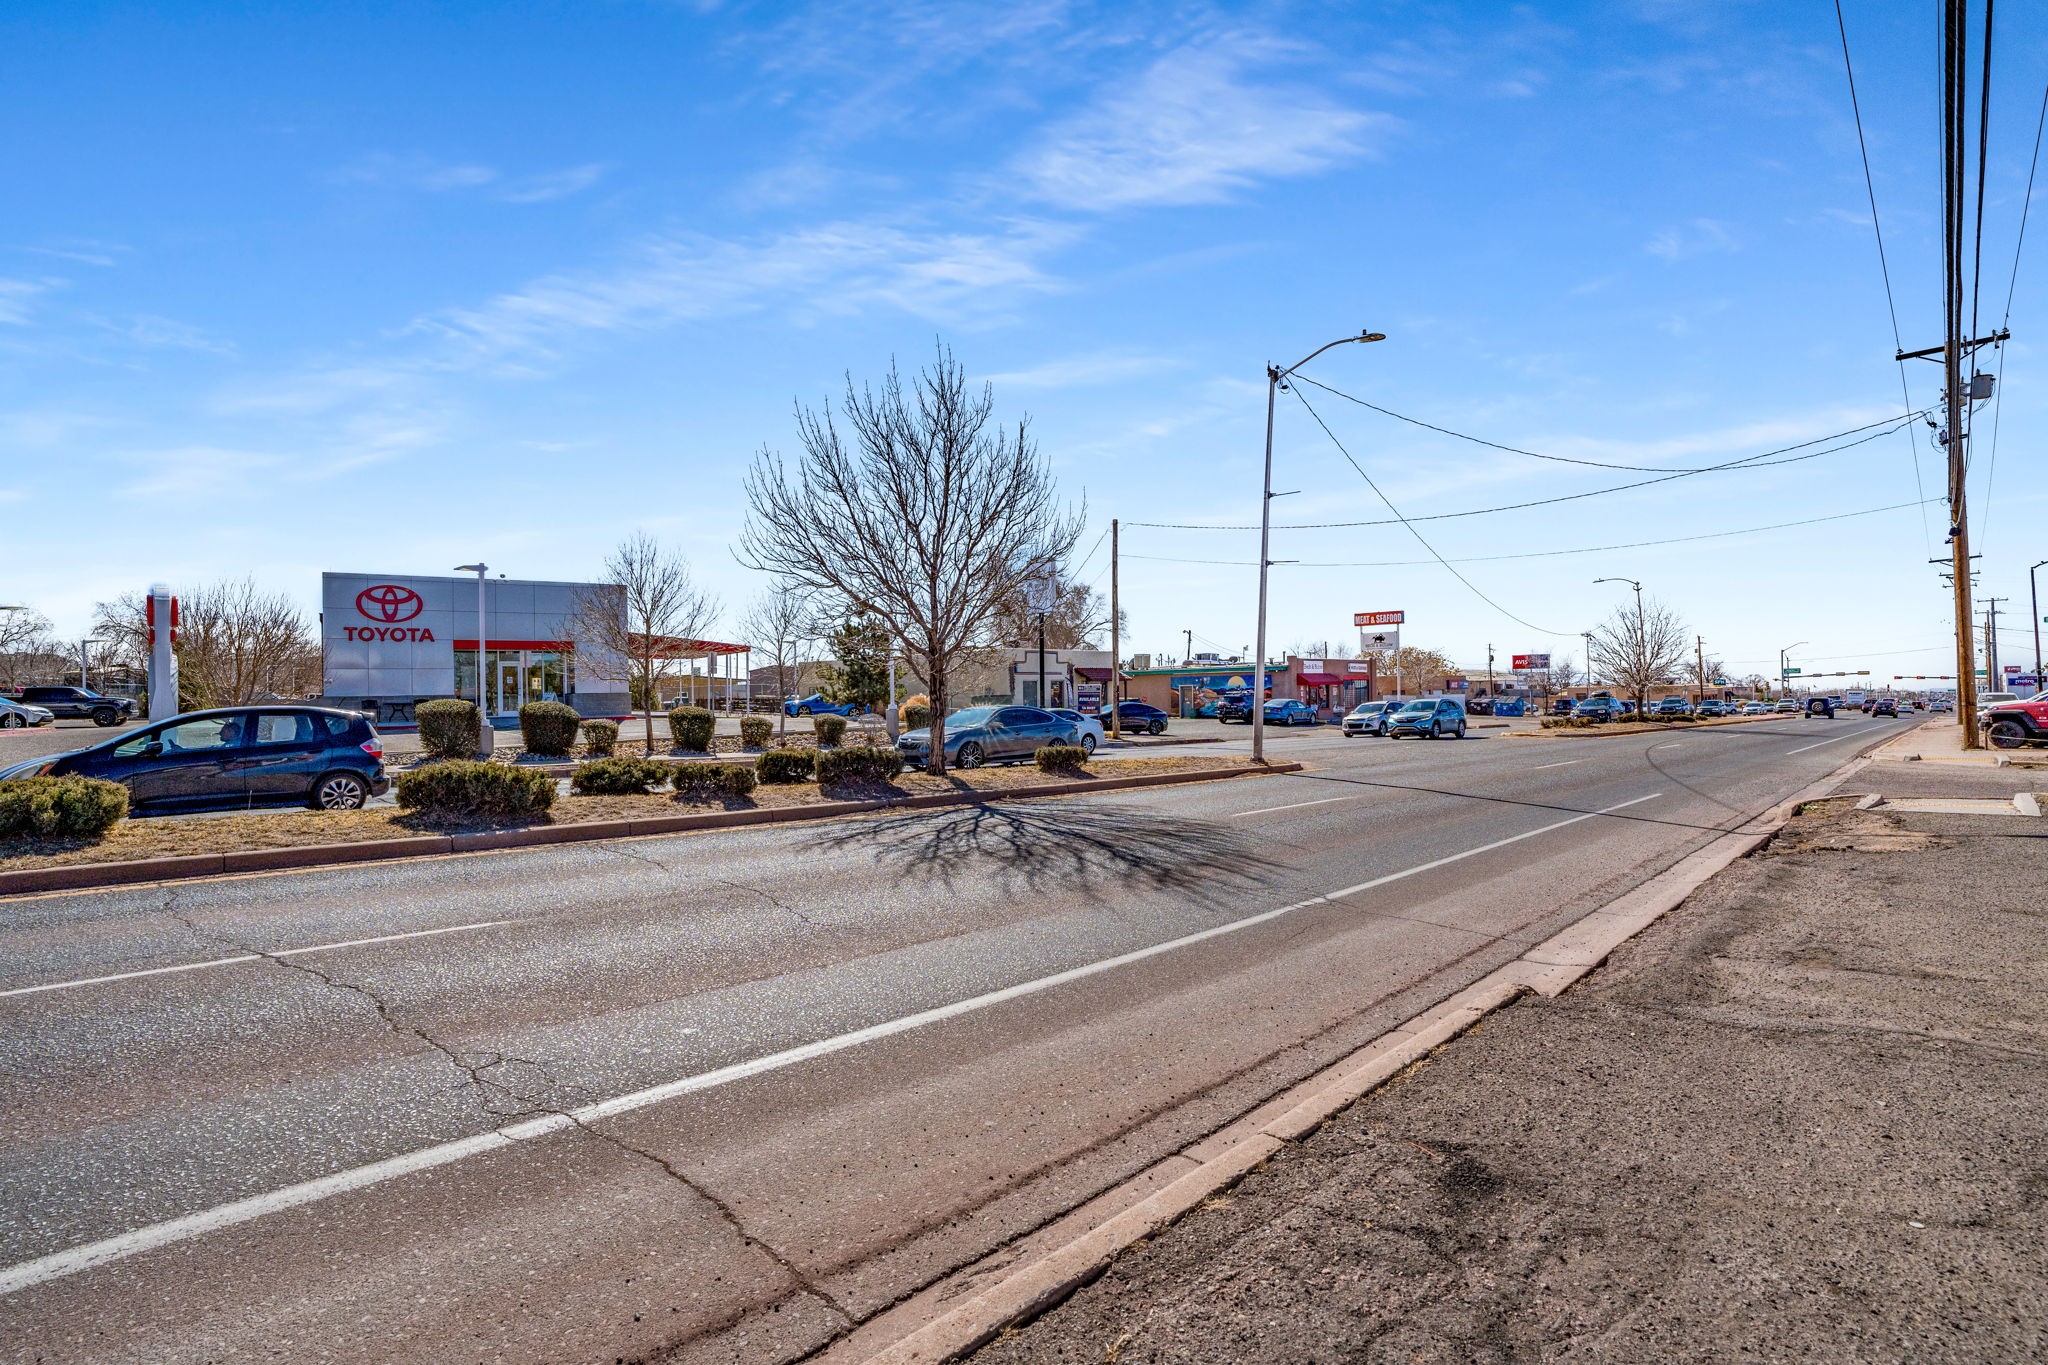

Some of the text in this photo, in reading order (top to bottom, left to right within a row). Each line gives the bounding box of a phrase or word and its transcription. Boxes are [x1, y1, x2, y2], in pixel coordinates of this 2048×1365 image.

[1355, 613, 1402, 624] MEAT & SEAFOOD
[343, 626, 435, 642] TOYOTA
